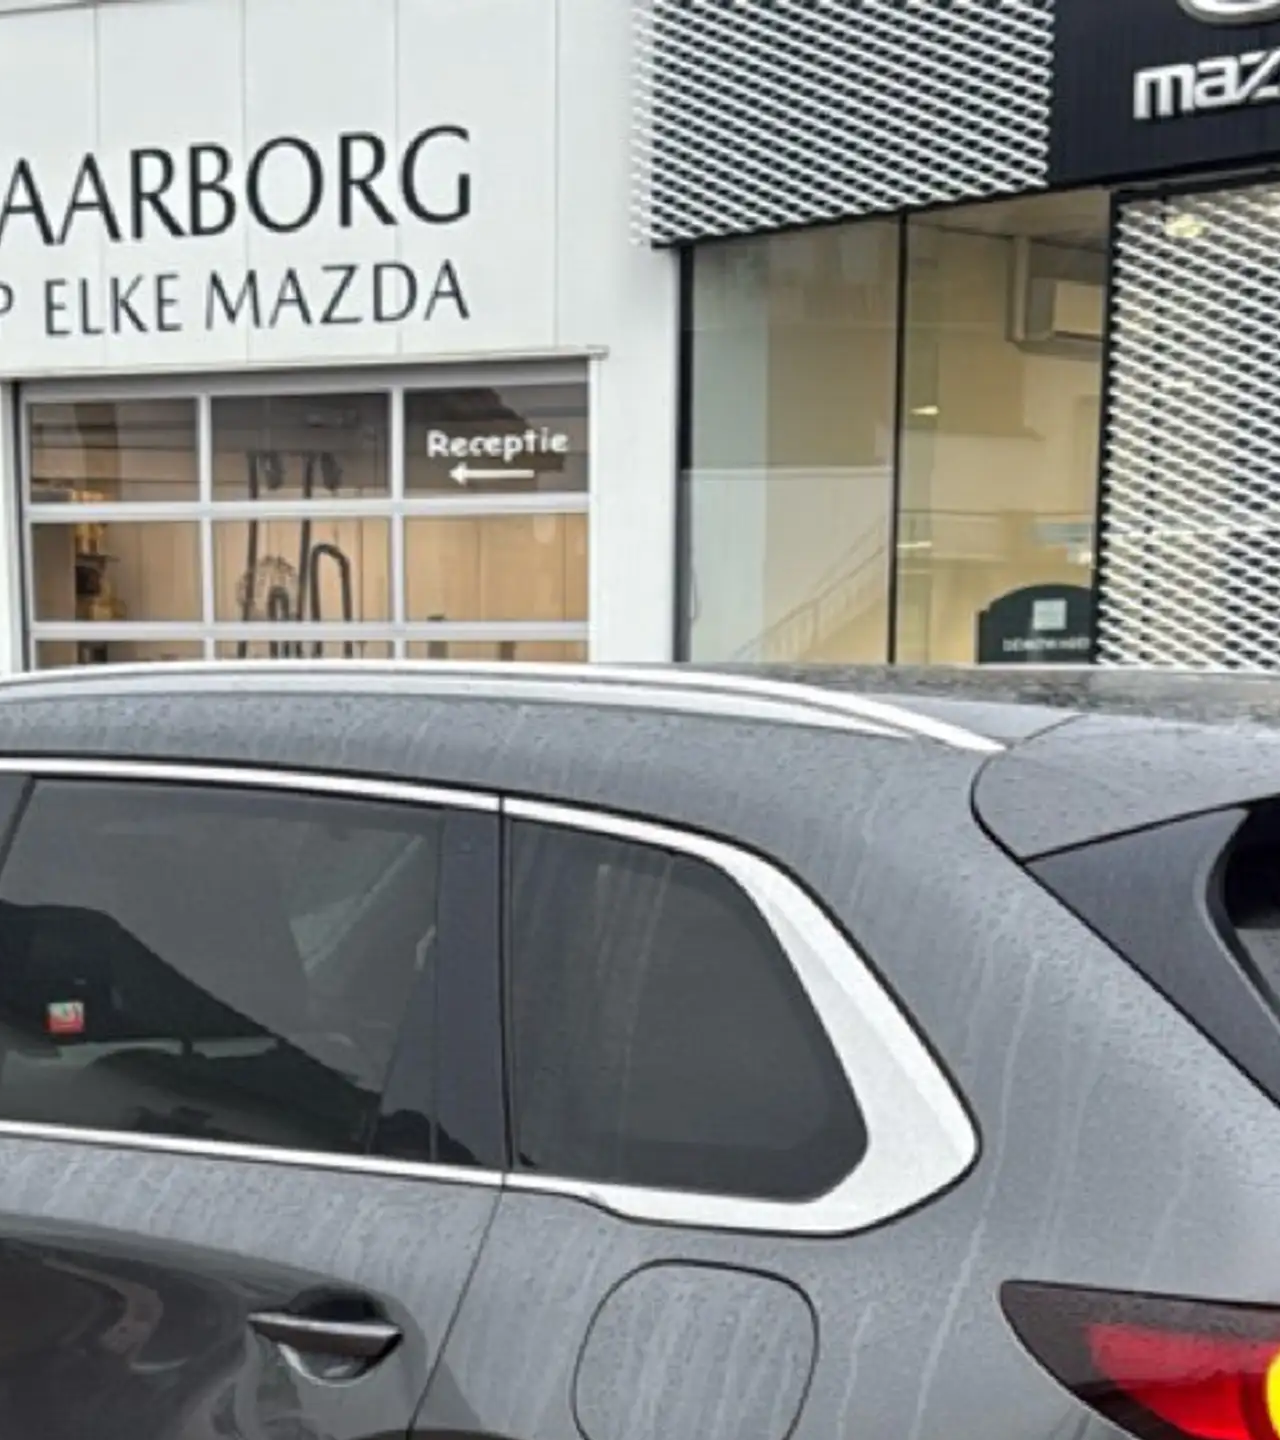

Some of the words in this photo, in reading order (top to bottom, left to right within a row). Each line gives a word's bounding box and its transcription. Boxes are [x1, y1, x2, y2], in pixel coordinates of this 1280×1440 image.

[43, 273, 183, 336] ELKE
[205, 258, 471, 331] MAZDA
[426, 426, 569, 463] Receptie
